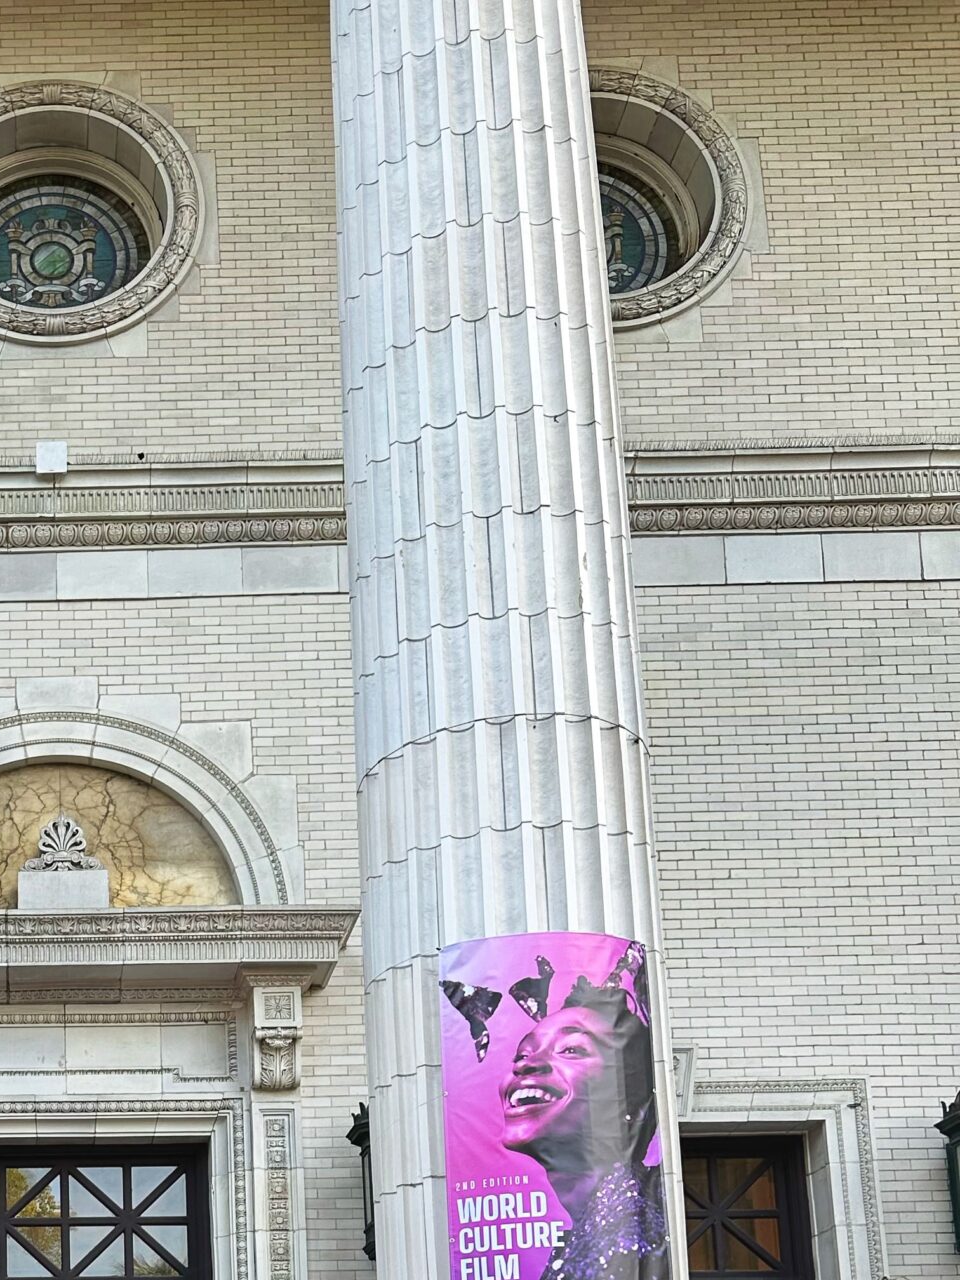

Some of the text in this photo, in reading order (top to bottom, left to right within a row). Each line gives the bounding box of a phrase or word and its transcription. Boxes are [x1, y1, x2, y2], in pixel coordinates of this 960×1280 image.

[455, 1175, 529, 1192] 2ND EDITION
[457, 1191, 547, 1224] WORLD
[459, 1221, 565, 1254] CULTURE
